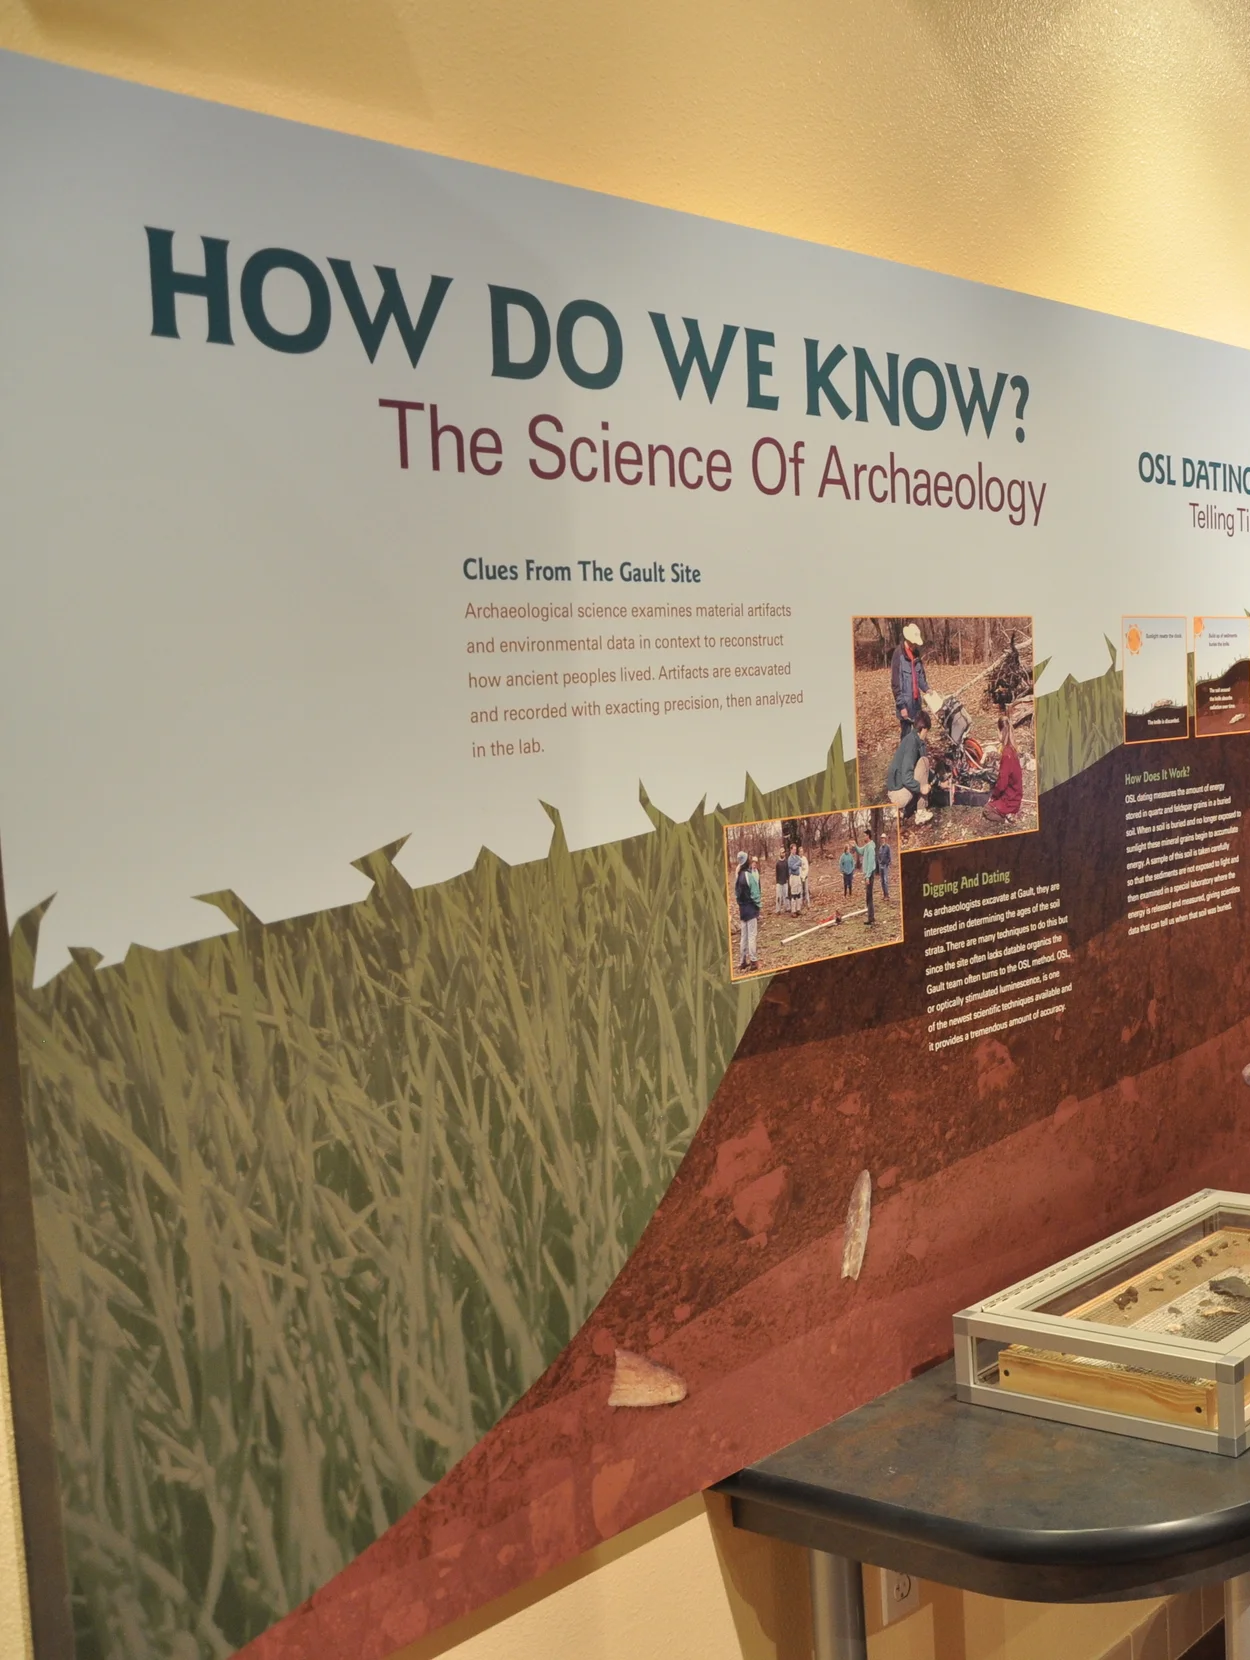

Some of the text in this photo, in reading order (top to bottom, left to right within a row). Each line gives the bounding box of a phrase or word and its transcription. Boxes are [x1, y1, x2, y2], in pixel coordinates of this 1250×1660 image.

[144, 226, 1029, 439] HOW DO WE KNOW?
[380, 400, 1046, 527] The Science Of Archaeology
[1138, 452, 1176, 485] OSL
[1189, 503, 1235, 537] Telling
[463, 557, 701, 583] Clues From The Gault Site
[465, 602, 792, 621] Archaeological science examines material artifacts
[466, 634, 784, 654] and environmental data in context to reconstruct
[468, 662, 791, 688] how ancient peoples lived. Artifacts are excavated
[470, 690, 803, 723] and recorded with exacting precision, then analyzed
[472, 738, 544, 758] in the lab.
[1125, 766, 1190, 785] How Does It Work?
[923, 870, 1010, 898] Digging And Dating
[923, 883, 1060, 918] As archaeologists excavate at Gault, they are
[924, 899, 1060, 937] interested in determining the ages of the soil
[925, 945, 946, 956] strata.
[945, 941, 965, 951] There
[966, 938, 977, 947] are
[978, 934, 996, 943] many
[997, 926, 1030, 939] techniques
[1037, 920, 1046, 929] do
[1046, 918, 1058, 927] this
[1058, 916, 1068, 924] but
[925, 935, 1062, 976] since the site often lacks datable organics the
[926, 949, 1071, 994] Gault team often turns to the OSL method. OSL,
[927, 971, 1060, 1014] or optically stimulated luminescence, is one
[928, 983, 1072, 1033] of the newest scientific techniques available and
[928, 1004, 1066, 1051] it provides a tremendous amount of accuracy.
